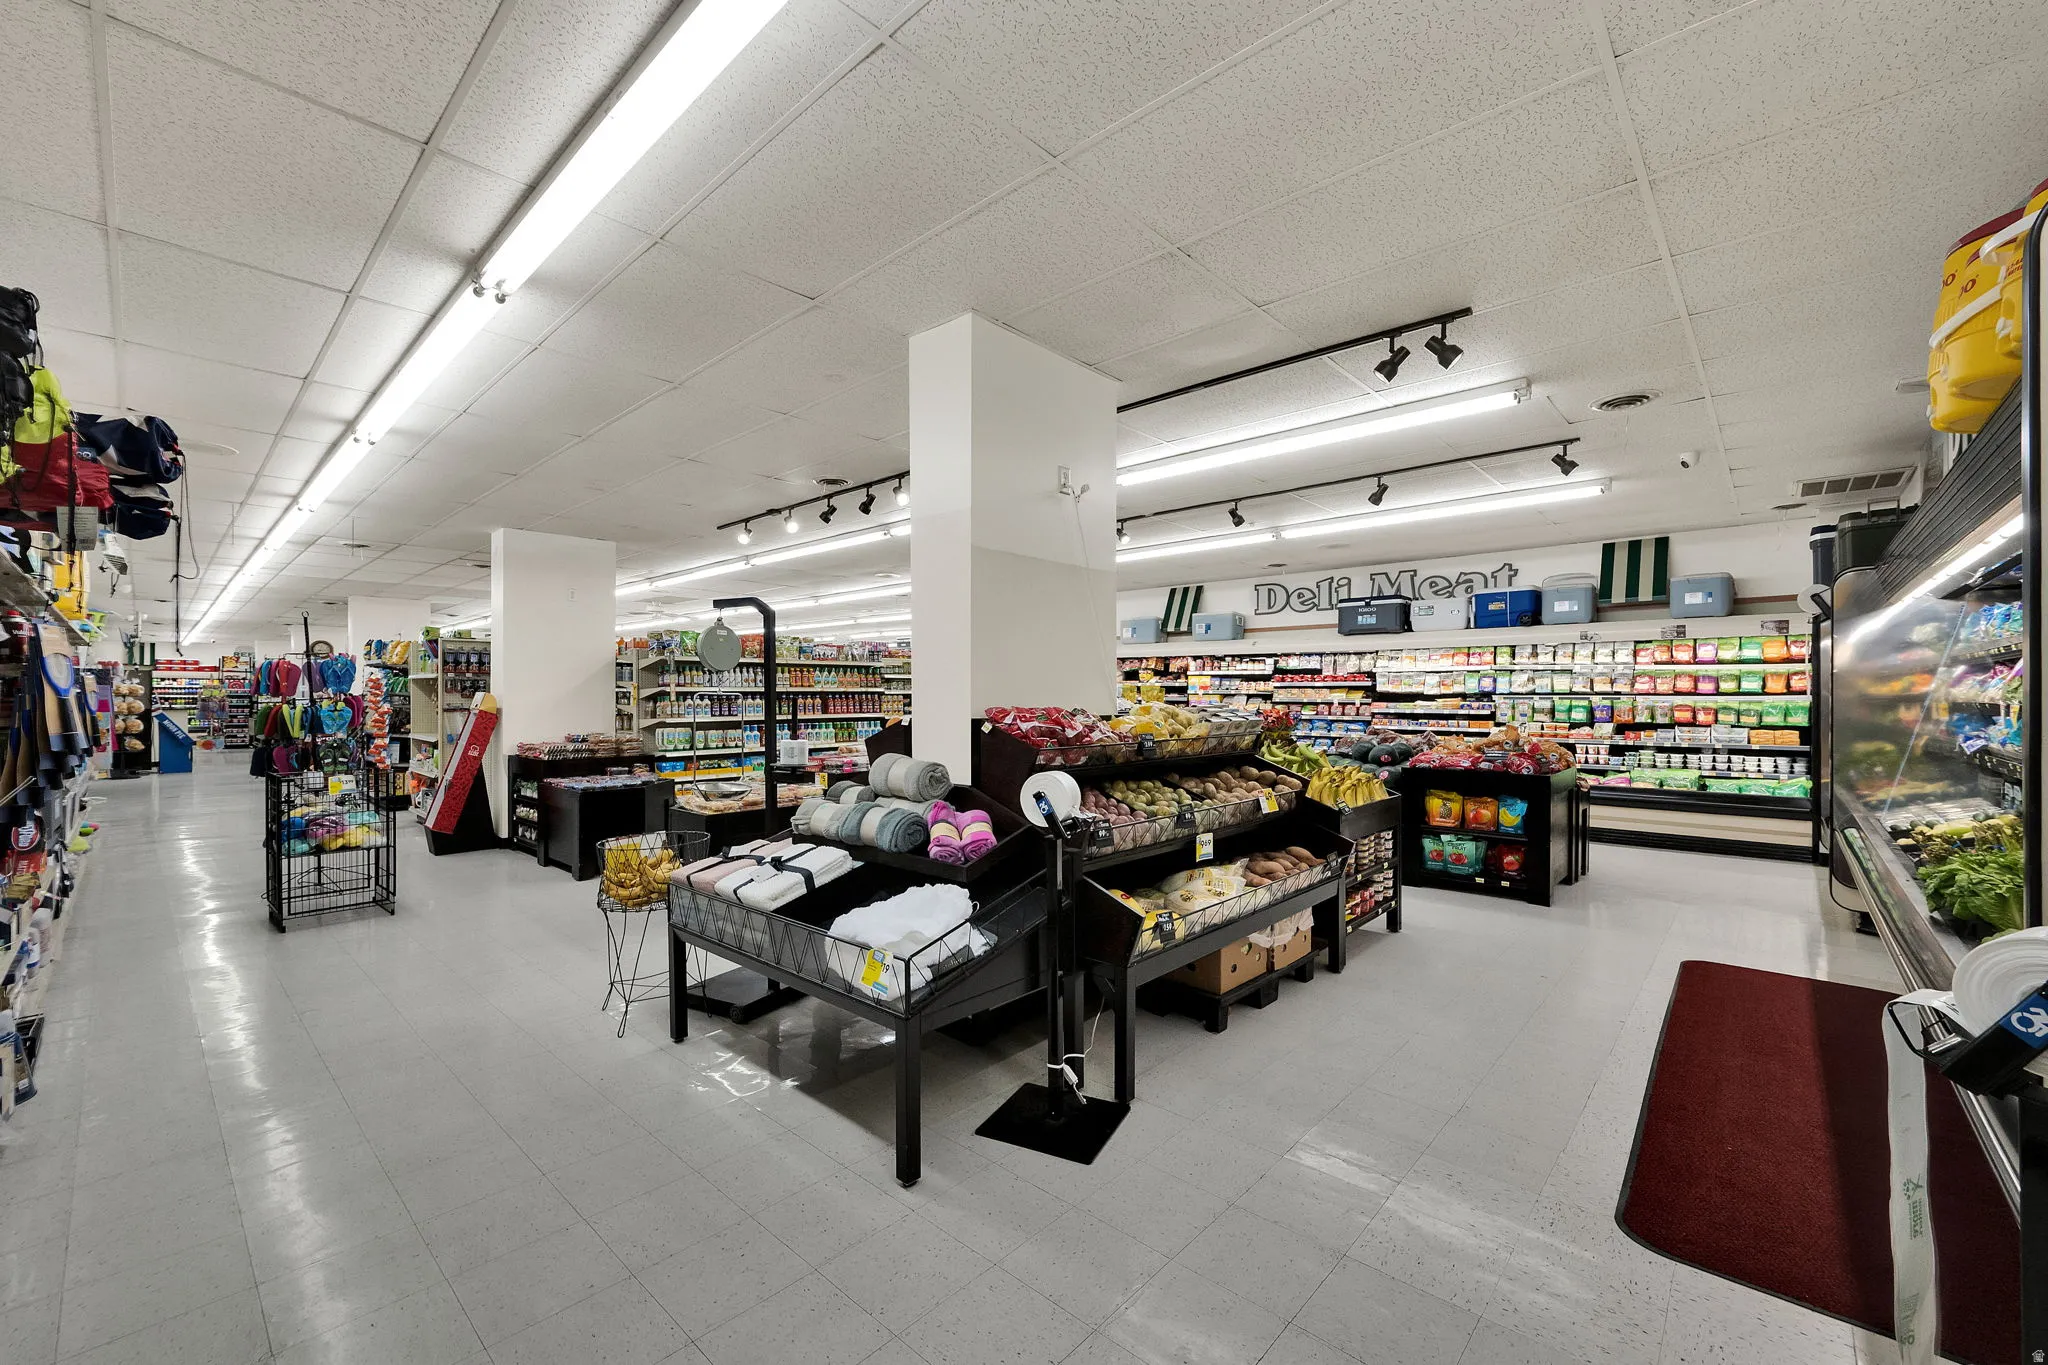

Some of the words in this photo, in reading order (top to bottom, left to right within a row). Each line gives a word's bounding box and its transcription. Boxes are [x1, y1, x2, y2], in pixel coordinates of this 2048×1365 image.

[1254, 576, 1351, 616] Deli
[1370, 563, 1519, 601] Meat
[162, 719, 179, 732] MOON
